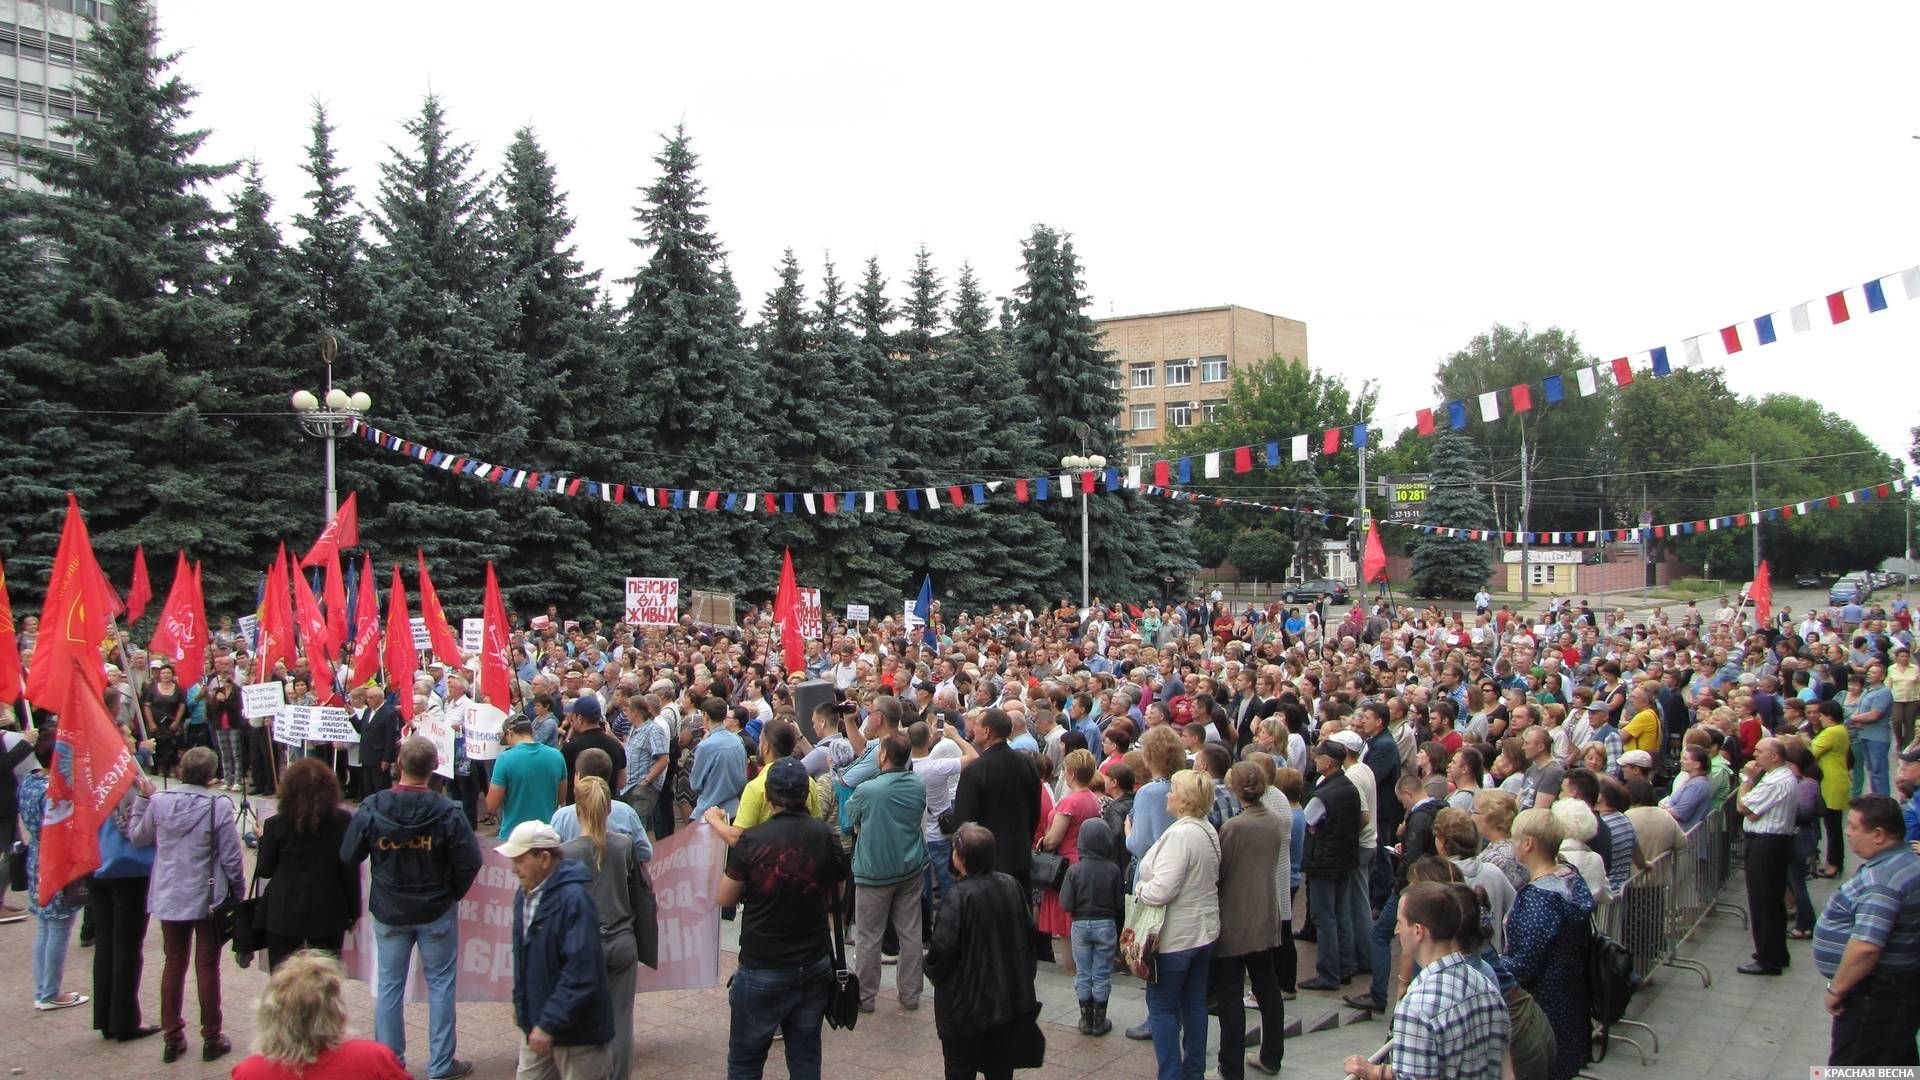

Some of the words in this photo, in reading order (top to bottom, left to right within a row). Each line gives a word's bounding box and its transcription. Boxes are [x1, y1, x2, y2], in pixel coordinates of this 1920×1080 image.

[1396, 491, 1407, 501] 10
[1408, 490, 1425, 501] 281
[628, 581, 677, 594] ПЕНСИЯ
[637, 594, 668, 607] ДЛЯ
[627, 607, 678, 623] ЖИВЫХ
